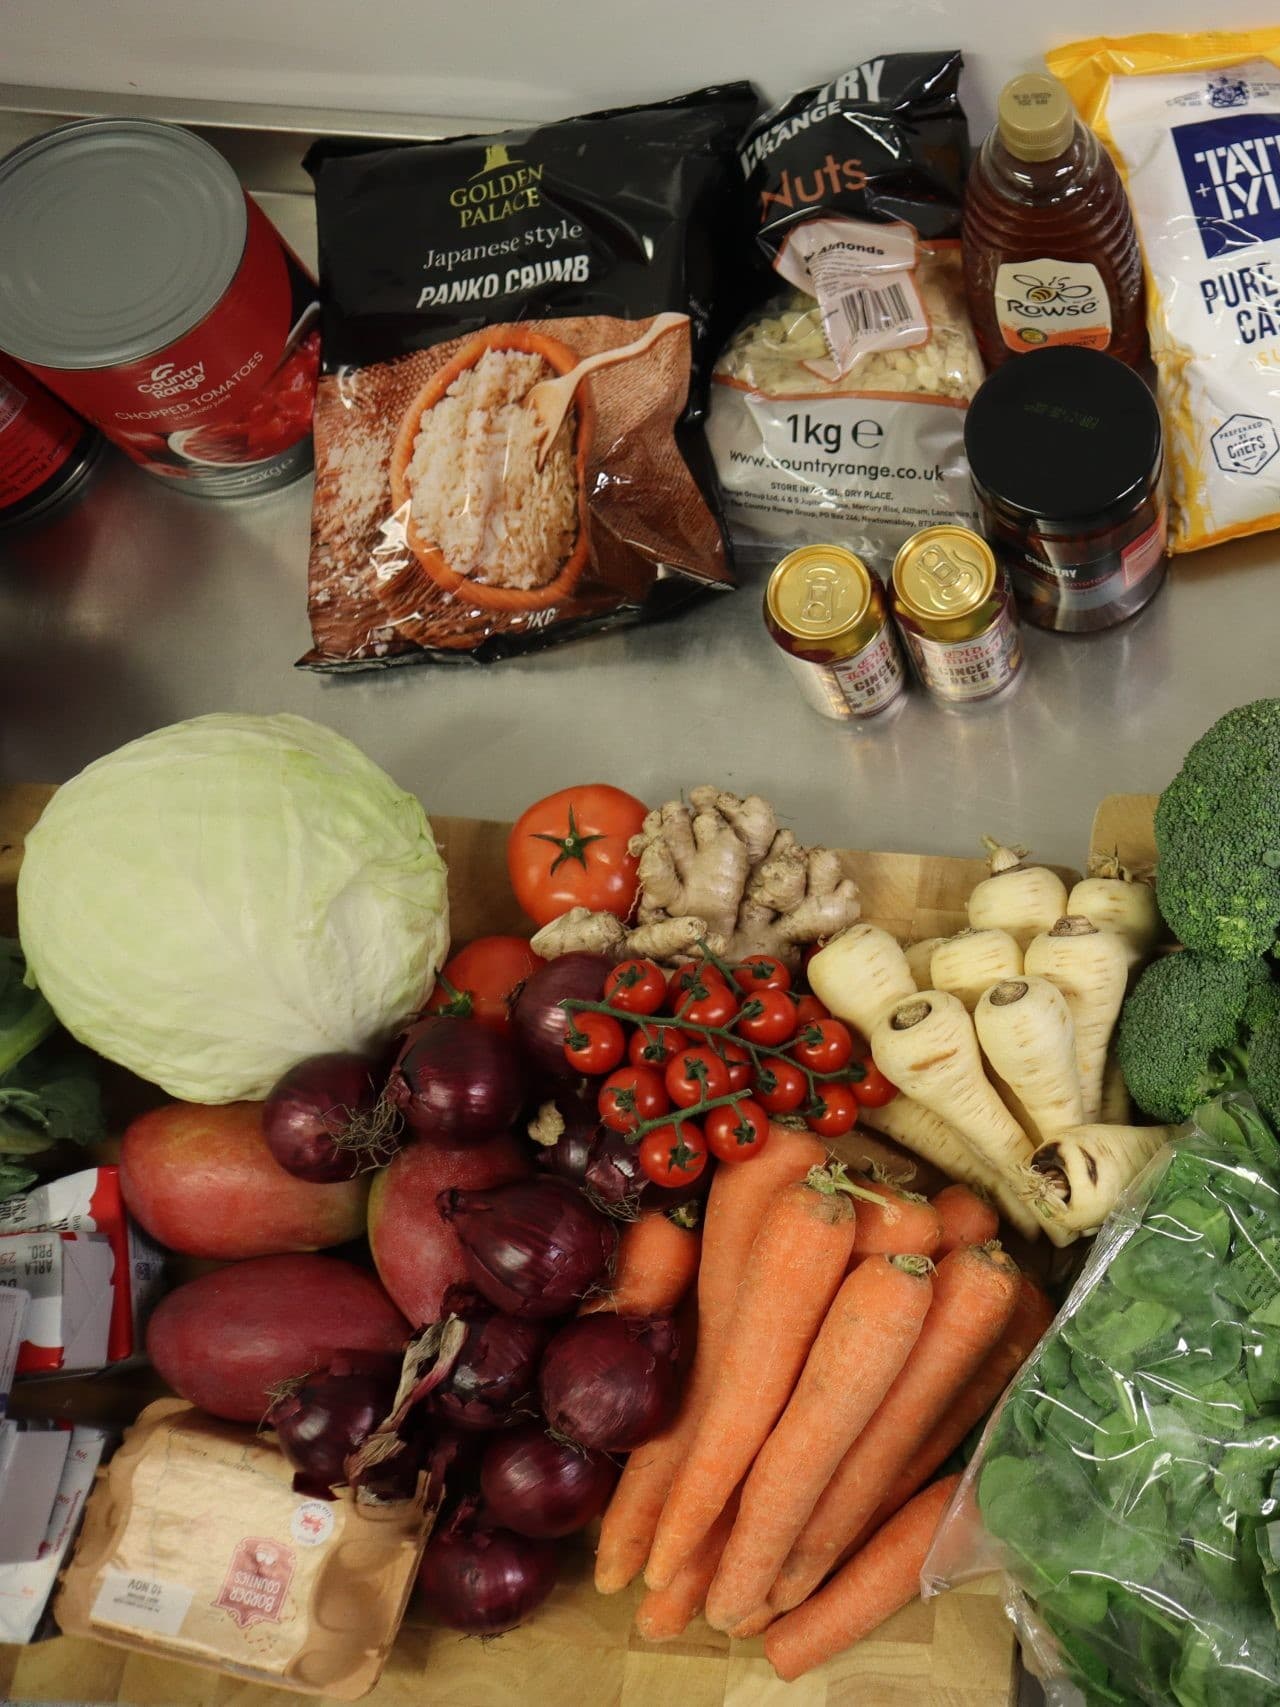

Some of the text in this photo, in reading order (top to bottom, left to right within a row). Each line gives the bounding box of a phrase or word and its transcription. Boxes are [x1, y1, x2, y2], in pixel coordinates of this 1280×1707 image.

[450, 163, 544, 208] GOLDEN
[459, 187, 541, 229] PALACE
[423, 219, 583, 272] Japanese style
[416, 254, 590, 309] PANKO CRUMB
[1200, 261, 1278, 314] PURE
[1006, 299, 1098, 318] Rowse
[115, 351, 264, 422] CHOPPED TOMATOES
[137, 361, 206, 394] Country
[152, 373, 206, 400] Range
[787, 413, 842, 455] 1kg
[1219, 421, 1263, 439] PREFERRED
[1227, 435, 1266, 459] CHEFS
[729, 449, 946, 482] www.countryrange.co.uk
[771, 482, 797, 492] STORE
[845, 489, 862, 498] DRY
[526, 610, 558, 629] 1KG
[25, 1260, 53, 1276] ARLA
[234, 1569, 281, 1595] COUNTIES
[229, 1585, 276, 1613] BORDER
